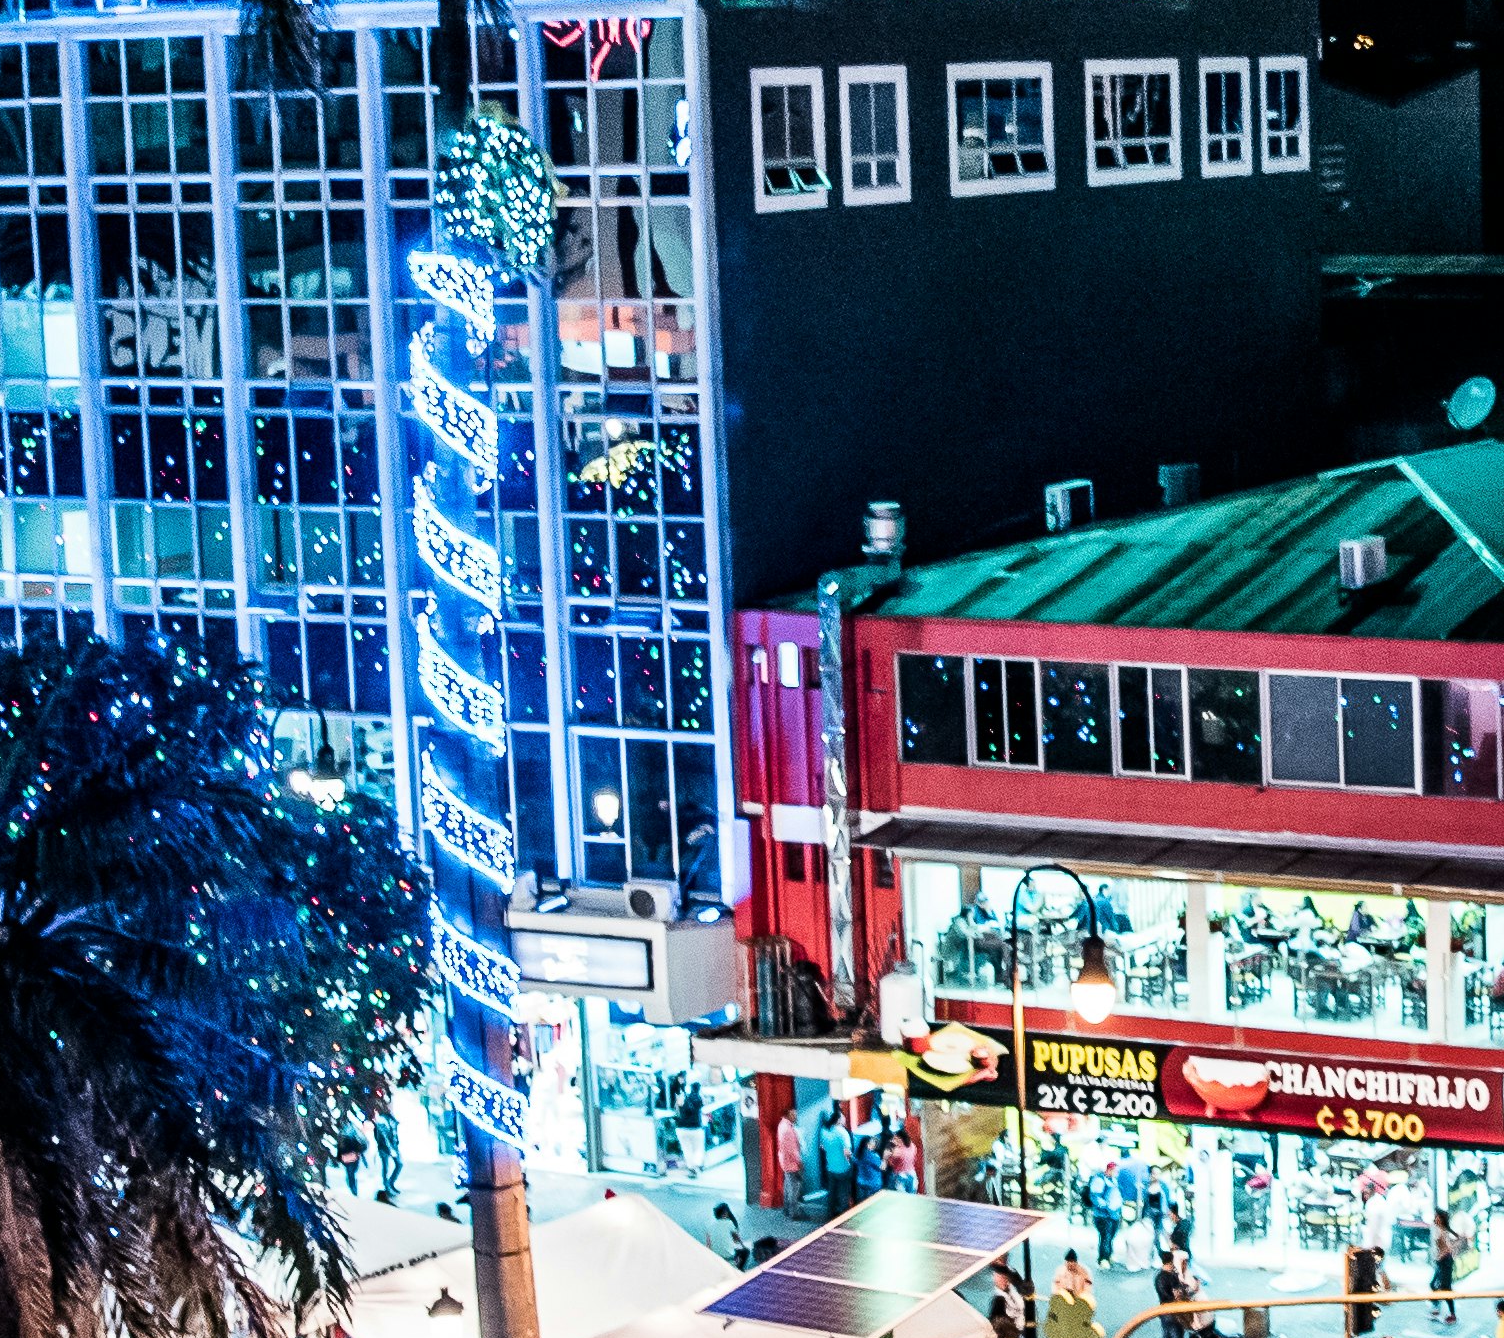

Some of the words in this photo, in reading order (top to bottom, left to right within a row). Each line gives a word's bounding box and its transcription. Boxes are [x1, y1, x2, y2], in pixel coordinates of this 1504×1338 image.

[1032, 1040, 1157, 1082] PUPUSAS
[1037, 1083, 1069, 1110] 2X
[1092, 1089, 1157, 1118] 2.200
[1264, 1061, 1490, 1112] CHANCHIFRIJO
[1343, 1108, 1425, 1142] 3.700
